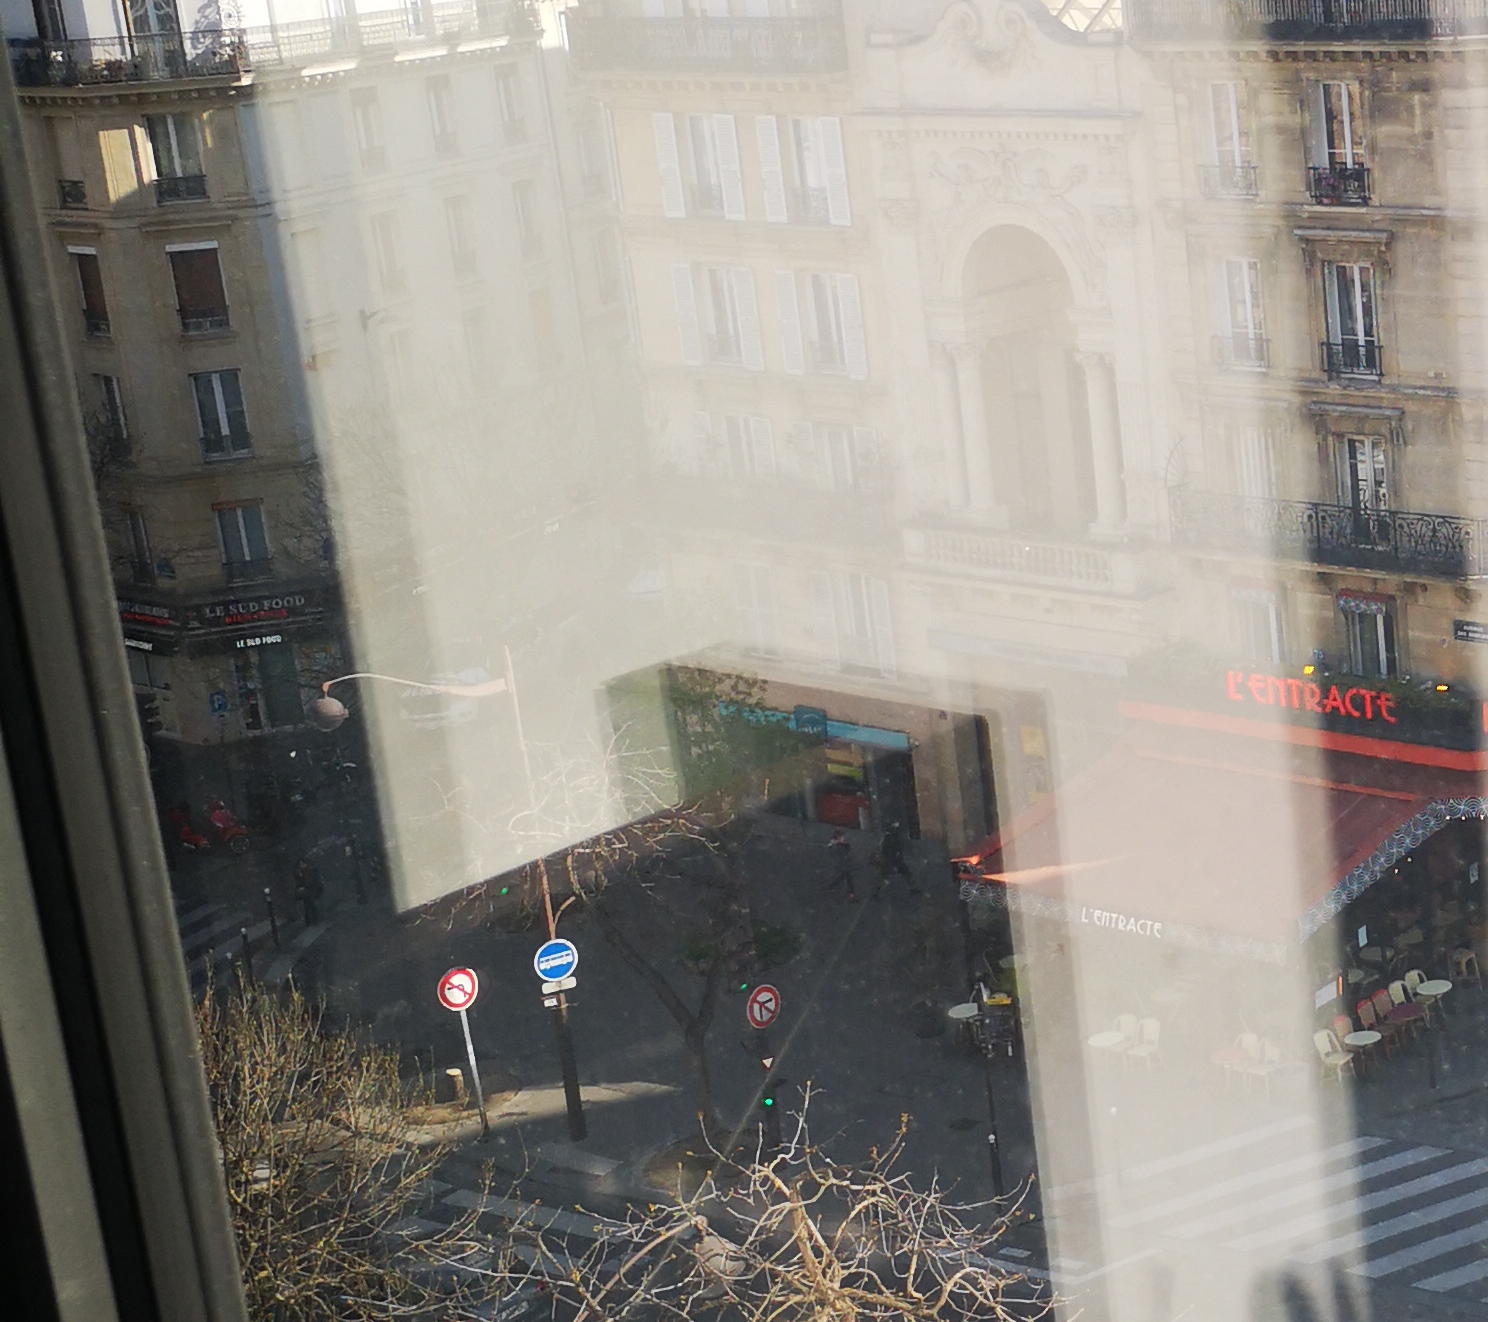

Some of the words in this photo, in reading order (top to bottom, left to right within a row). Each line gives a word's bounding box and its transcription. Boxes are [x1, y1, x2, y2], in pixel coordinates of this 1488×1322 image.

[263, 594, 306, 611] FOOD
[1226, 670, 1398, 725] L'ENTRACTE
[1081, 906, 1163, 939] L'ENTRACTE
